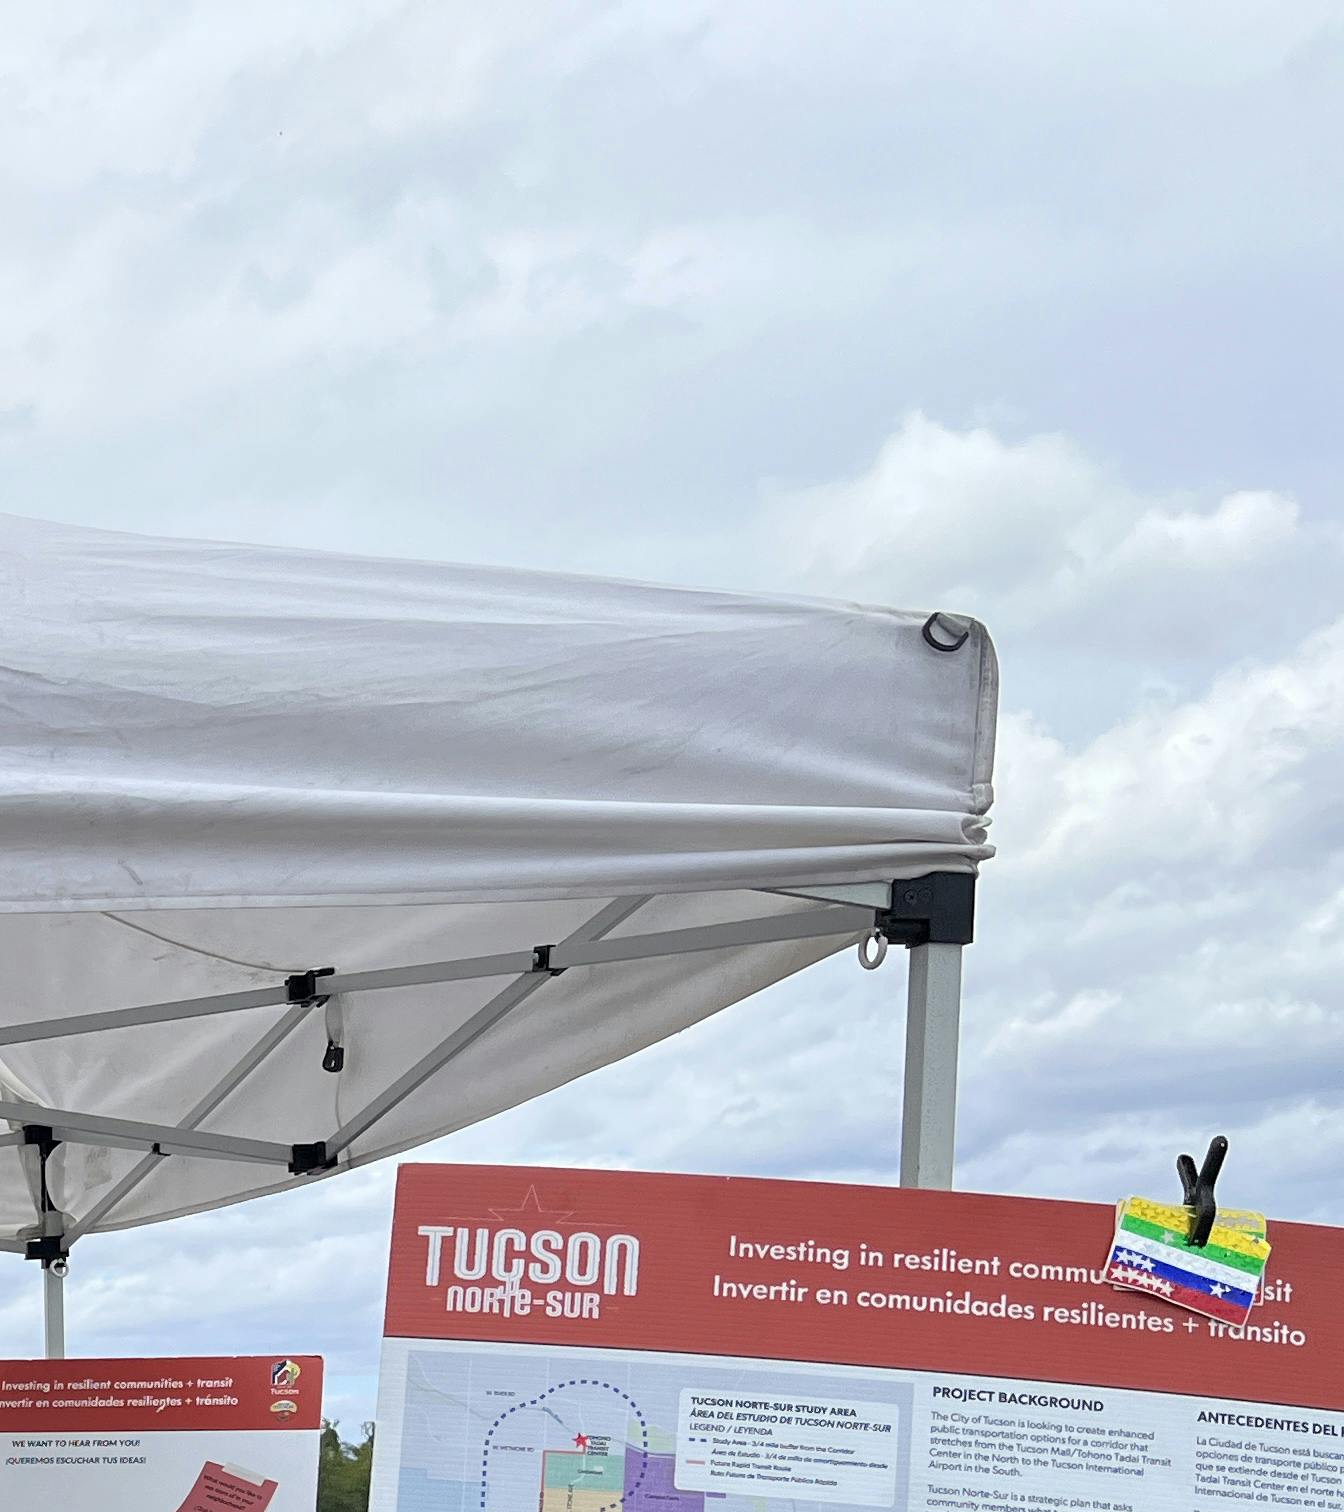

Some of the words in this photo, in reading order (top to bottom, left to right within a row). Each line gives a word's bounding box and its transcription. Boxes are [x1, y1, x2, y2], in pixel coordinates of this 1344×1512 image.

[417, 1225, 639, 1296] TUCSON
[729, 1235, 849, 1269] Investing
[859, 1243, 883, 1266] in
[893, 1248, 1000, 1274] resilient
[713, 1275, 808, 1301] Invertir
[815, 1288, 847, 1305] en
[856, 1291, 1034, 1319] comunidades
[1042, 1302, 1174, 1331] resilientes
[1182, 1317, 1200, 1334] +
[1, 1380, 50, 1392] Investing
[53, 1379, 64, 1390] in
[66, 1378, 111, 1389] resilient
[113, 1377, 183, 1389] communities
[186, 1379, 193, 1387] +
[196, 1376, 233, 1387] transit
[35, 1399, 49, 1407] en
[51, 1395, 124, 1407] comunidades
[126, 1395, 182, 1407] resilientes
[195, 1394, 238, 1405] tránsito
[690, 1396, 733, 1407] TUCSON
[734, 1400, 793, 1411] NORTE-SUR
[794, 1404, 828, 1414] STUDY
[829, 1407, 857, 1417] AREA
[932, 1386, 995, 1402] PROJECT
[998, 1392, 1104, 1411] BACKGROUND
[1196, 1411, 1309, 1432] ANTECEDENTES
[1312, 1422, 1338, 1436] DEL
[26, 1439, 53, 1447] WANT
[54, 1439, 66, 1447] TO
[68, 1439, 90, 1447] HEAR
[92, 1439, 117, 1447] FROM
